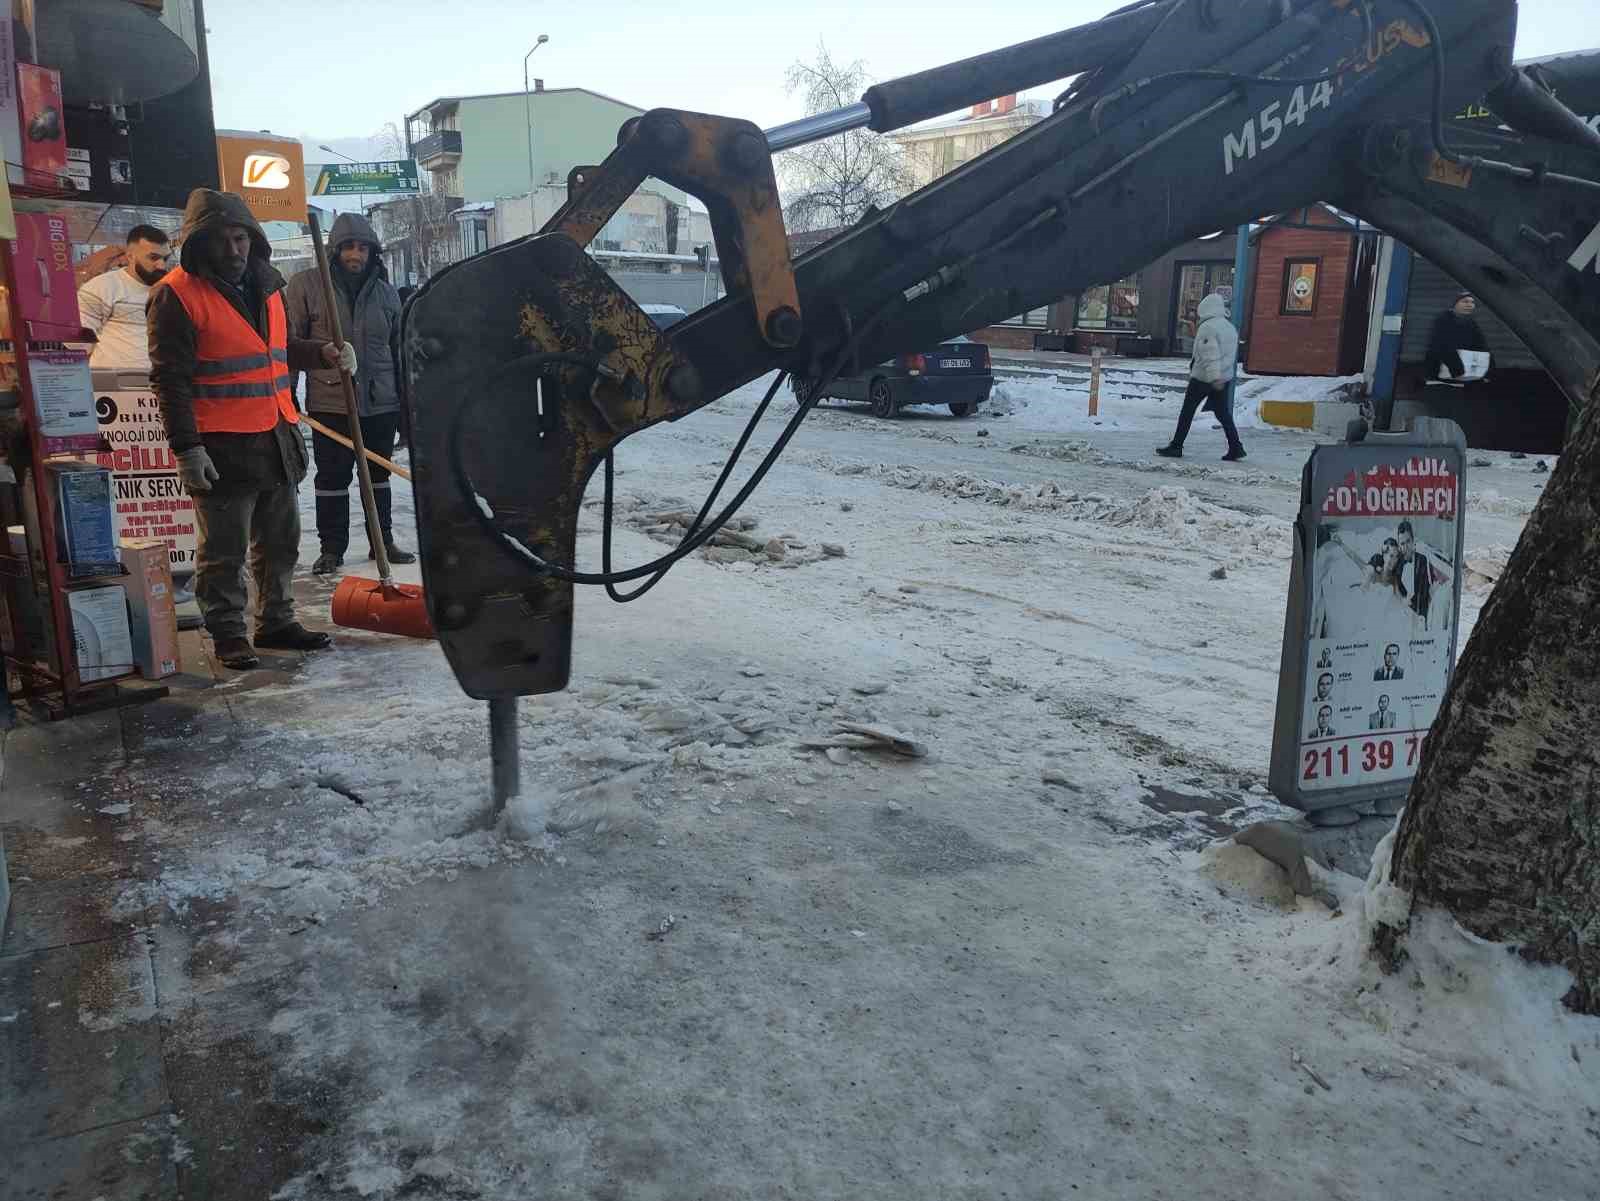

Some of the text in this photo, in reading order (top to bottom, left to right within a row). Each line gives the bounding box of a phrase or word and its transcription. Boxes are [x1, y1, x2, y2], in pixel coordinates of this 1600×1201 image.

[1223, 68, 1334, 175] M544
[98, 426, 145, 442] KNOLOJİ
[148, 479, 183, 497] SERV
[1304, 737, 1424, 780] 211 39 7
